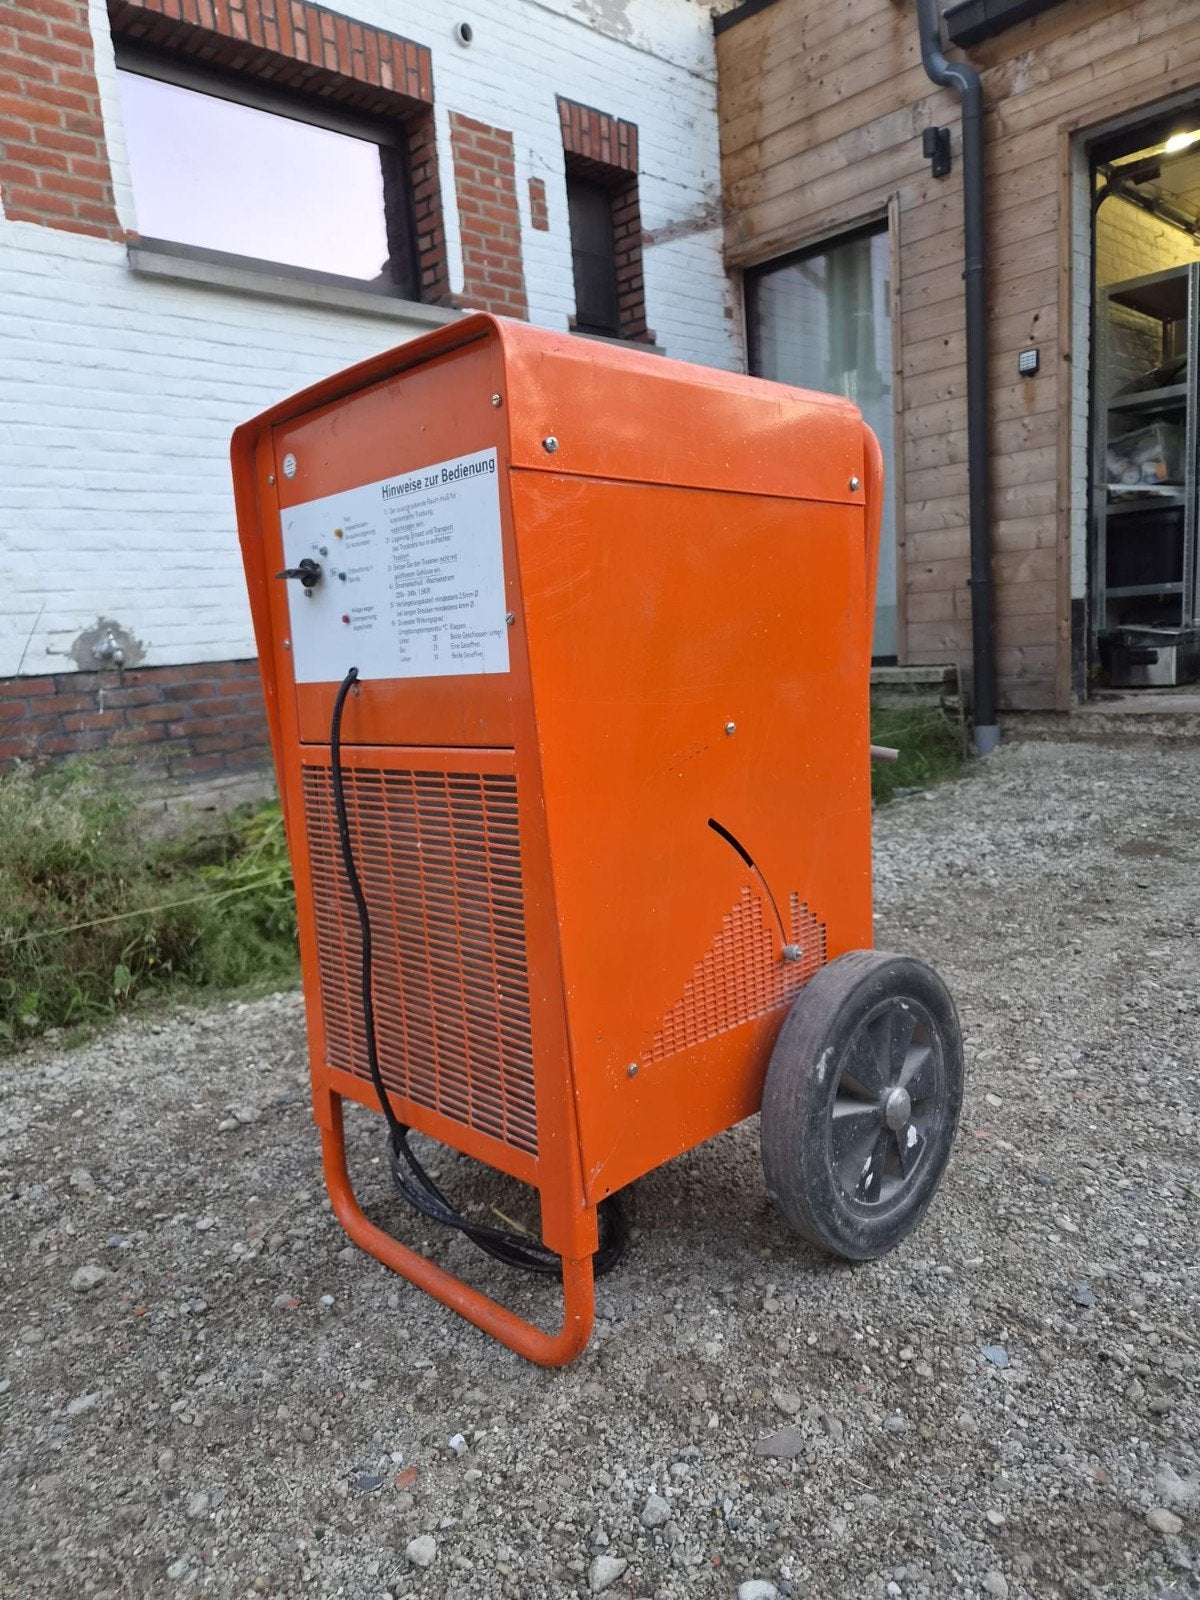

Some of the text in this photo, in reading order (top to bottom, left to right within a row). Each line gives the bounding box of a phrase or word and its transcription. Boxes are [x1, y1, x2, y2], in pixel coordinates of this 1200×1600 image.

[381, 458, 495, 499] Hinweise zur Bedienung
[434, 523, 453, 534] Transport
[439, 555, 449, 563] nicht
